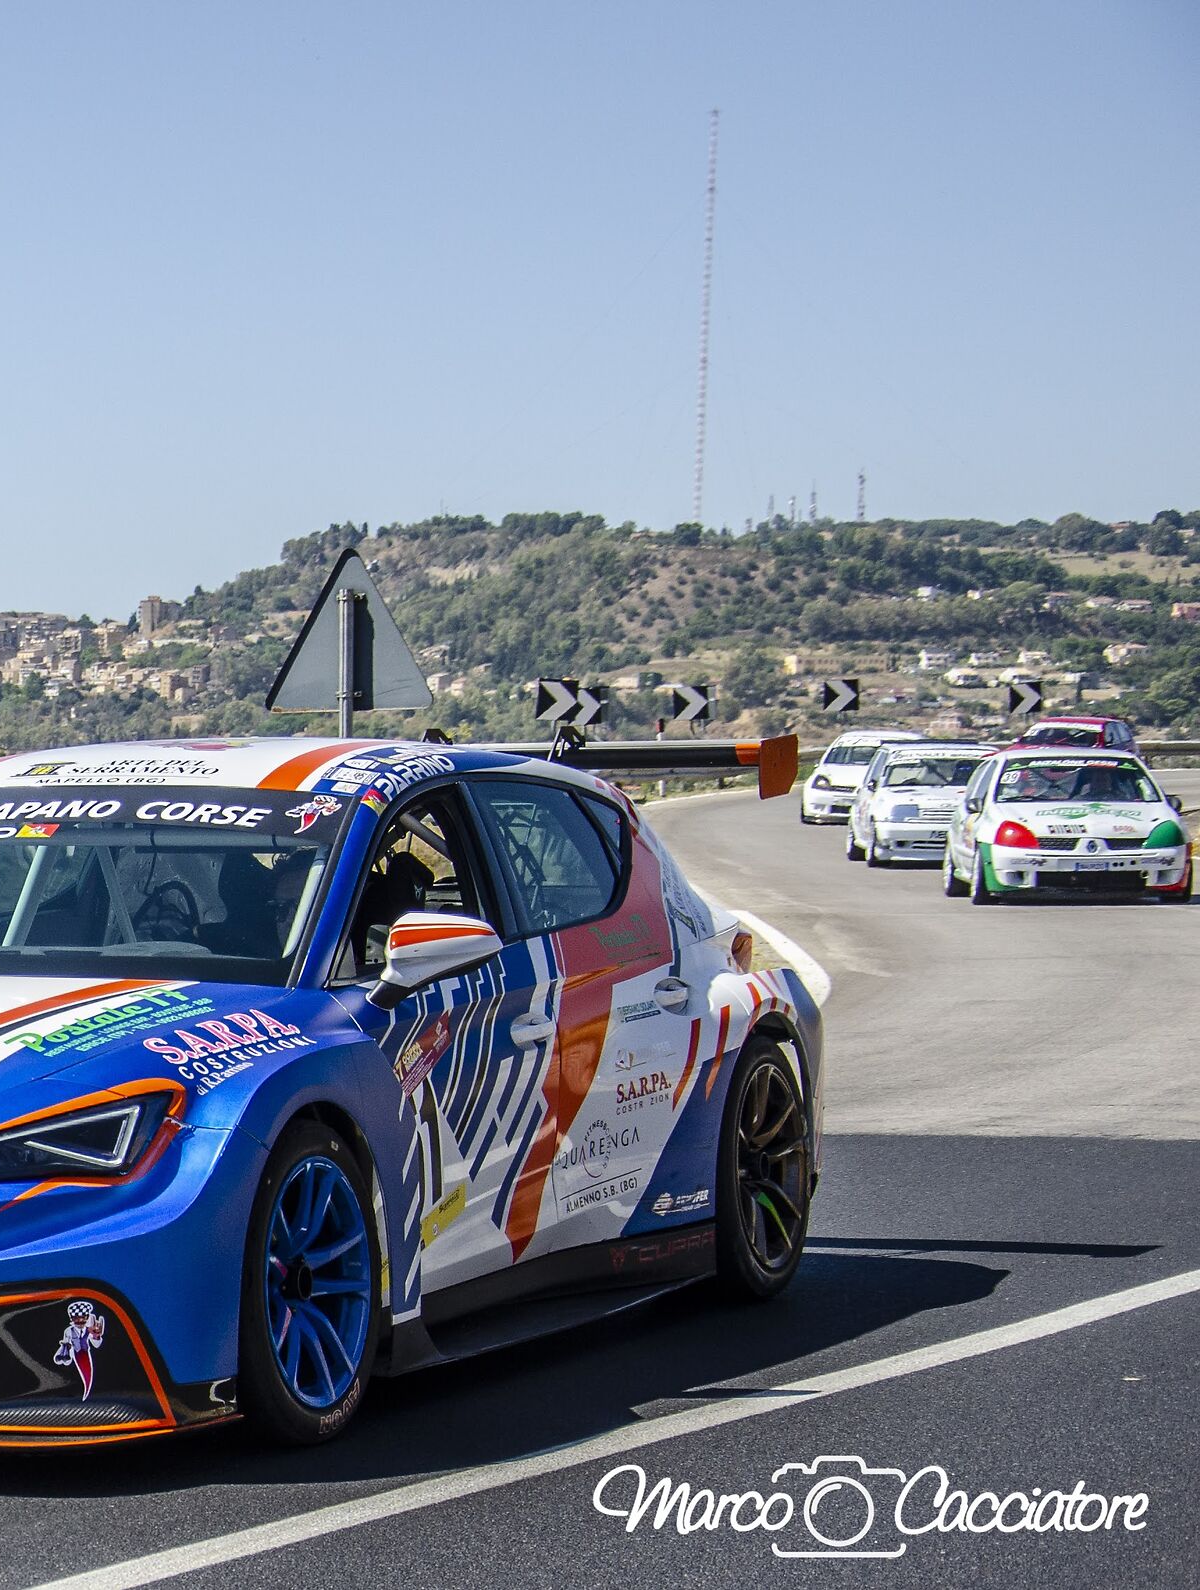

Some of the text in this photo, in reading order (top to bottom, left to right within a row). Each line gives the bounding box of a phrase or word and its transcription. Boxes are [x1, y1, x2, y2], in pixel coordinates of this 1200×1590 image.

[374, 754, 456, 801] PARRINO
[135, 801, 274, 828] CORSE
[4, 1003, 153, 1052] Postale
[178, 1035, 317, 1080] COSTRUZIONI
[566, 1191, 601, 1214] ALMENNO
[620, 1177, 638, 1194] (BG)
